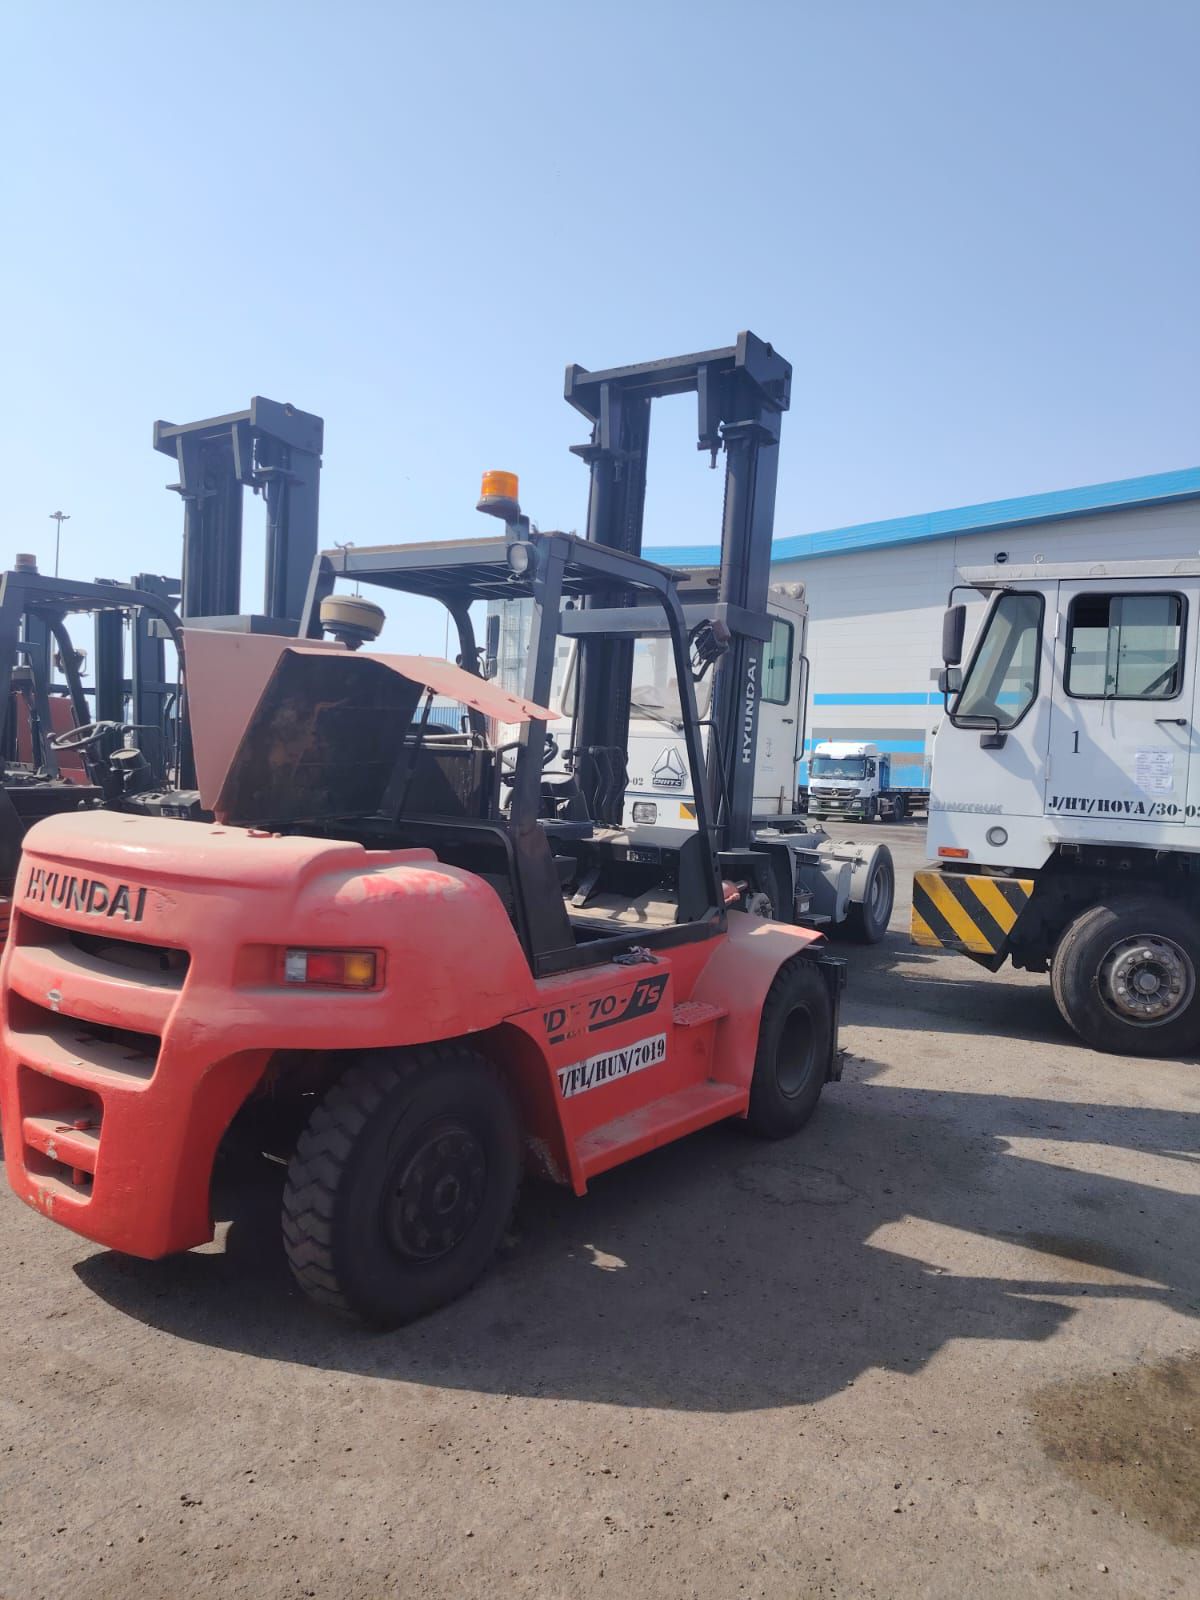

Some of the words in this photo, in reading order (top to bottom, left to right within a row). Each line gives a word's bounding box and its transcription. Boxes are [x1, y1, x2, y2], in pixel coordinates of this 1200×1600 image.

[742, 657, 757, 763] HYUNDAI
[1071, 730, 1080, 754] 1
[25, 867, 147, 922] HYUNDAI
